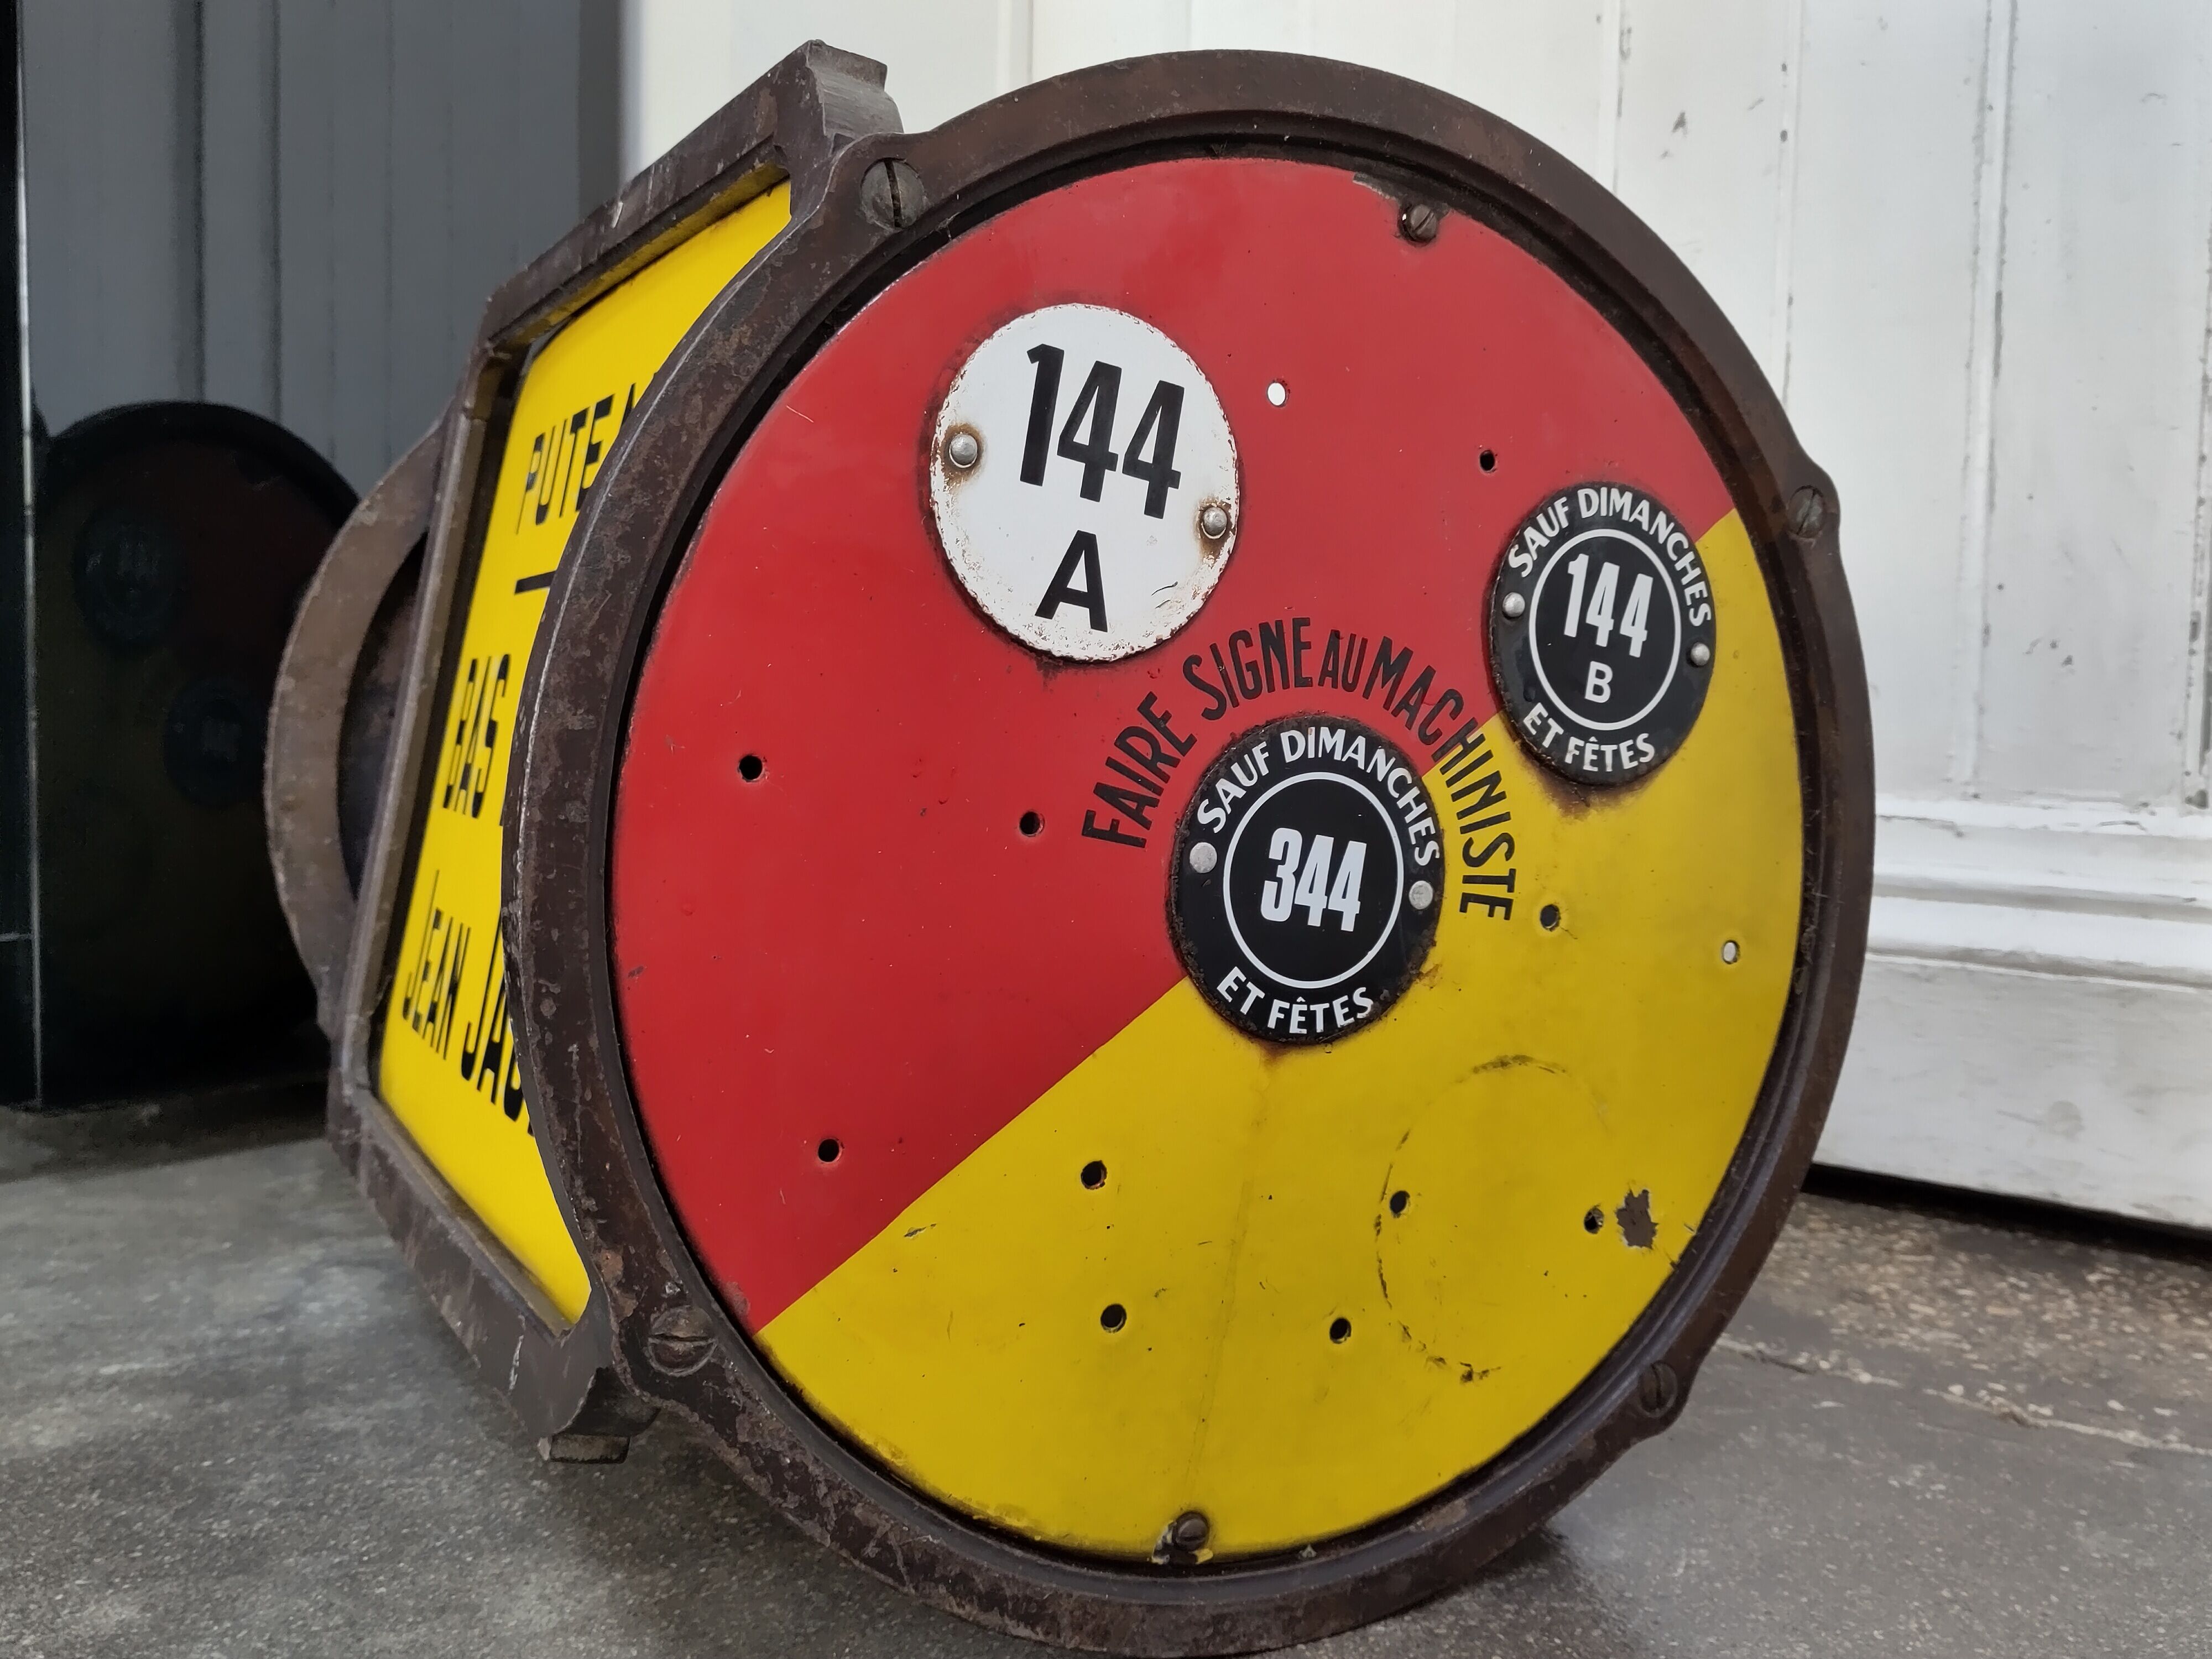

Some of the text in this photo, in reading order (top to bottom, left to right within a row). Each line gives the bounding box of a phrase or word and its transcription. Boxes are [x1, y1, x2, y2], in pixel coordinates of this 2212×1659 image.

[515, 383, 637, 535] PUTE
[1020, 343, 1185, 519] 144
[1035, 530, 1108, 633] A
[1508, 487, 1712, 627] SAUF DIMANCHES
[1564, 553, 1654, 658] 144
[442, 654, 510, 818] BAS
[1523, 702, 1656, 772] ET FÊTES
[1584, 660, 1614, 704] B
[1081, 617, 1516, 921] FAIRE SIGNE AU MACHINISTE
[1197, 727, 1440, 867] SAUF DIMANCHES
[1260, 827, 1367, 932] 344
[403, 868, 471, 1060] JEAN
[1217, 966, 1374, 1034] ET FÊTES
